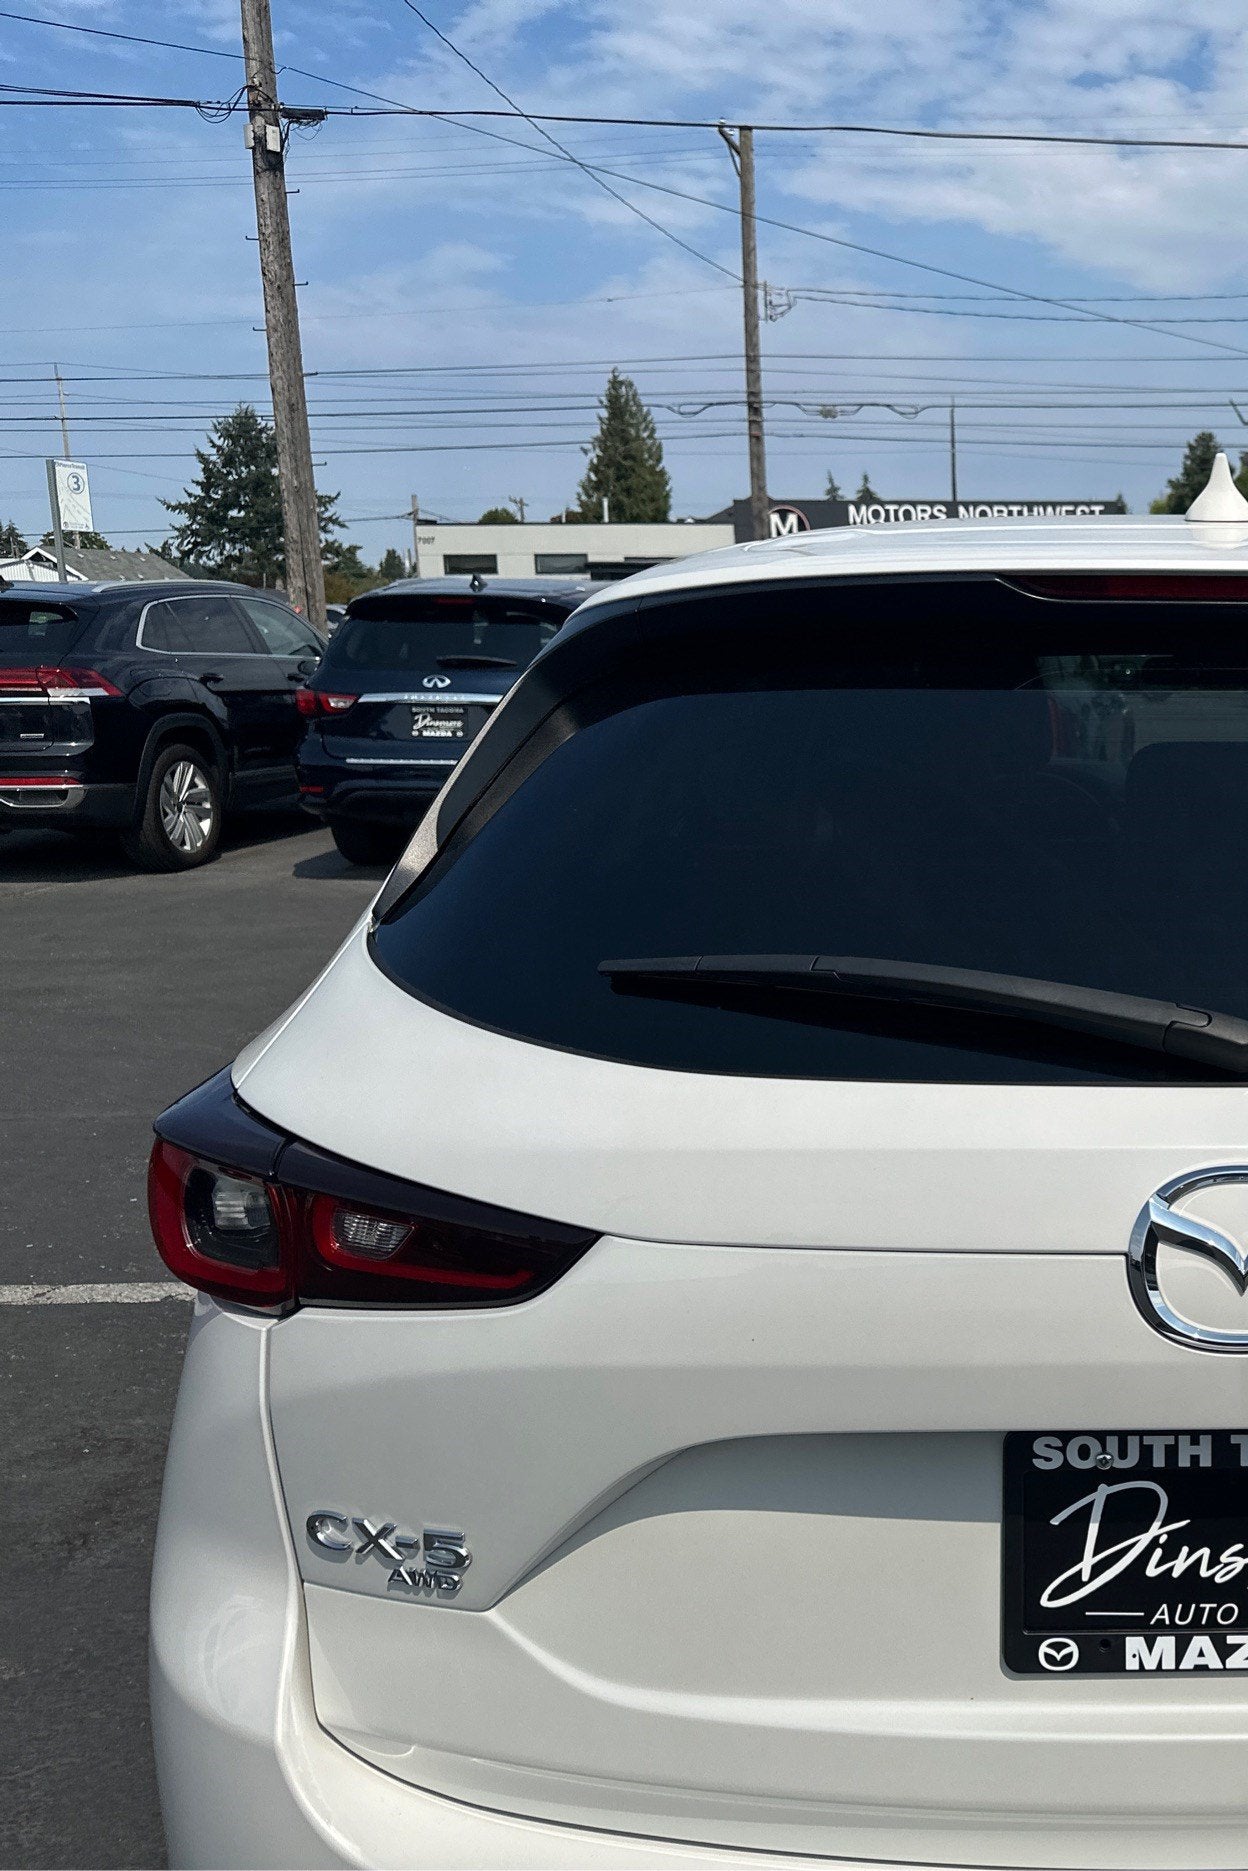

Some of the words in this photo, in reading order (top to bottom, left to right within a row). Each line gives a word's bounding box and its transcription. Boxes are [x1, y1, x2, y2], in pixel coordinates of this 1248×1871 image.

[71, 475, 81, 491] 3
[769, 512, 799, 538] M
[848, 504, 948, 525] MOTORS
[1032, 1435, 1212, 1469] SOUTH
[306, 1509, 473, 1569] CX-5
[388, 1566, 463, 1591] AWD
[1150, 1604, 1239, 1625] AUTO
